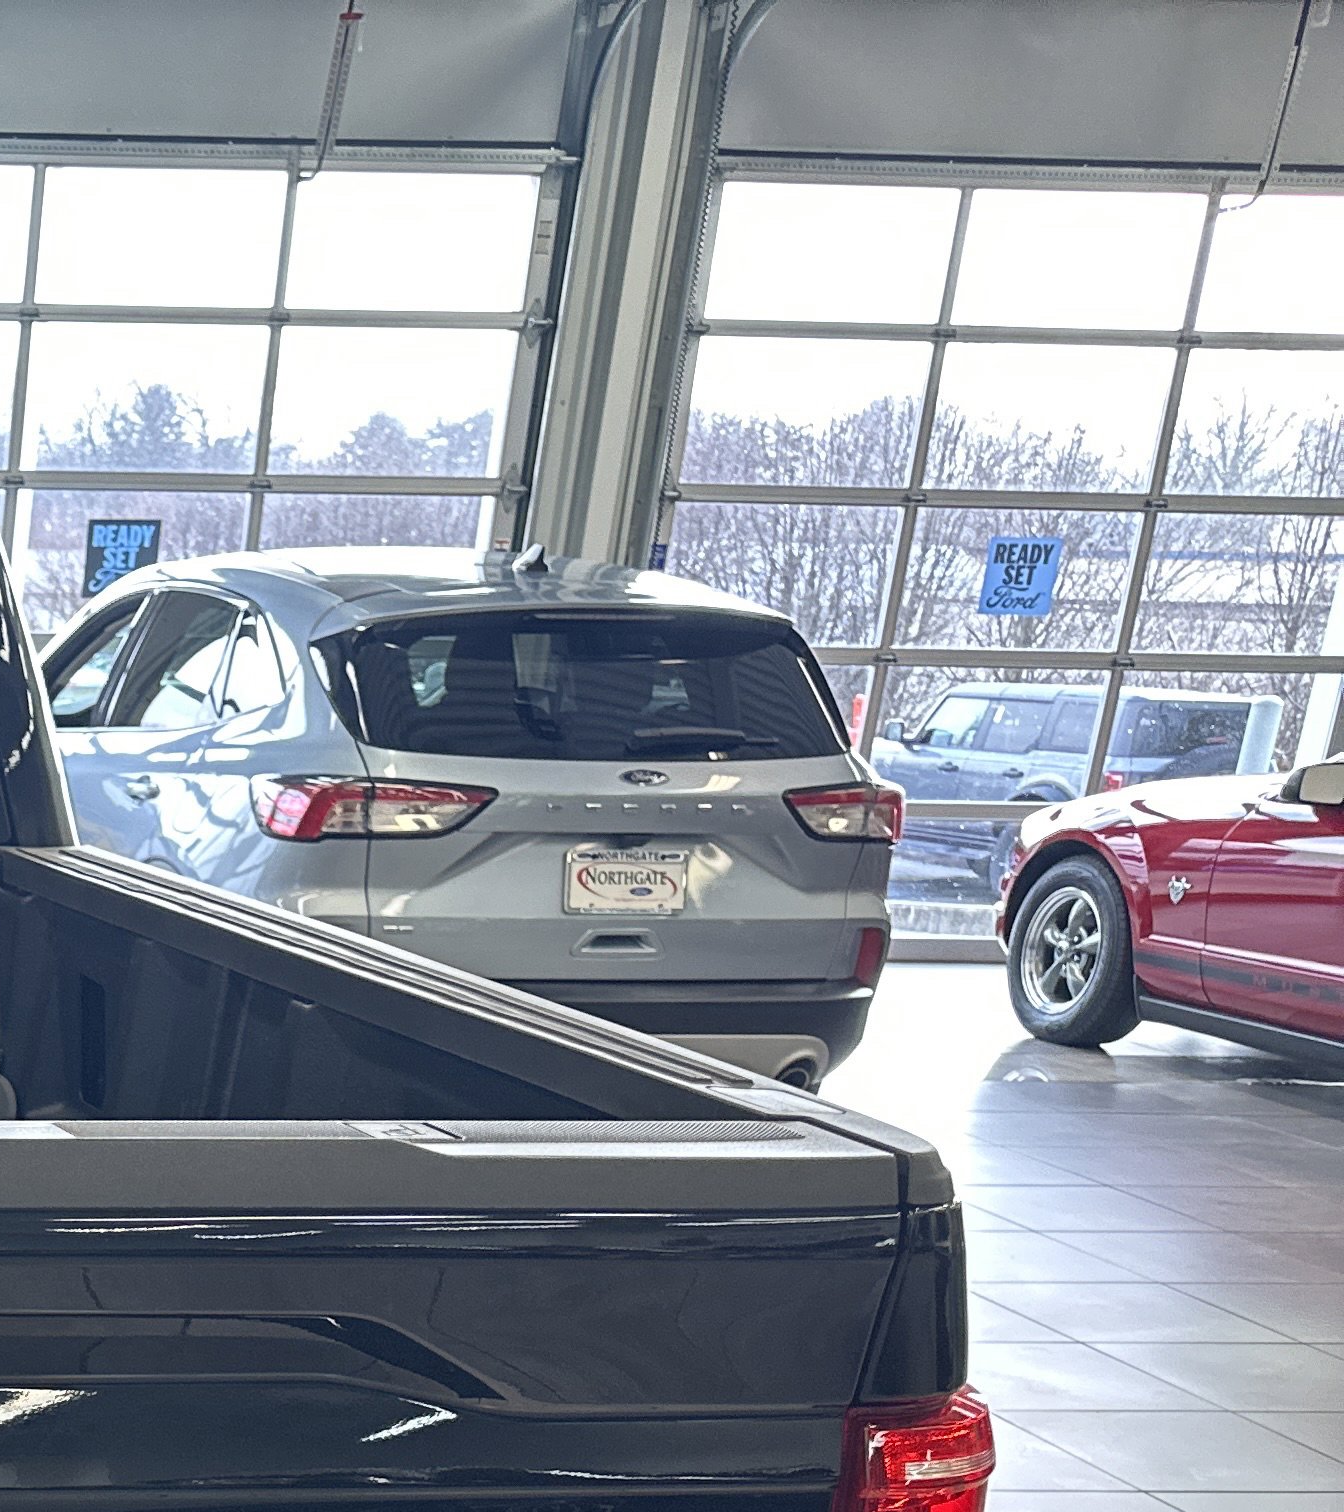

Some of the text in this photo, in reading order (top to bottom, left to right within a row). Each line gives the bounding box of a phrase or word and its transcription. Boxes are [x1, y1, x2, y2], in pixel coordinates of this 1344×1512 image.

[92, 524, 156, 548] READY
[102, 547, 139, 569] SET
[993, 543, 1054, 564] READY
[1002, 565, 1037, 585] SET
[986, 585, 1041, 609] Ford
[585, 867, 667, 885] NORTHGATE
